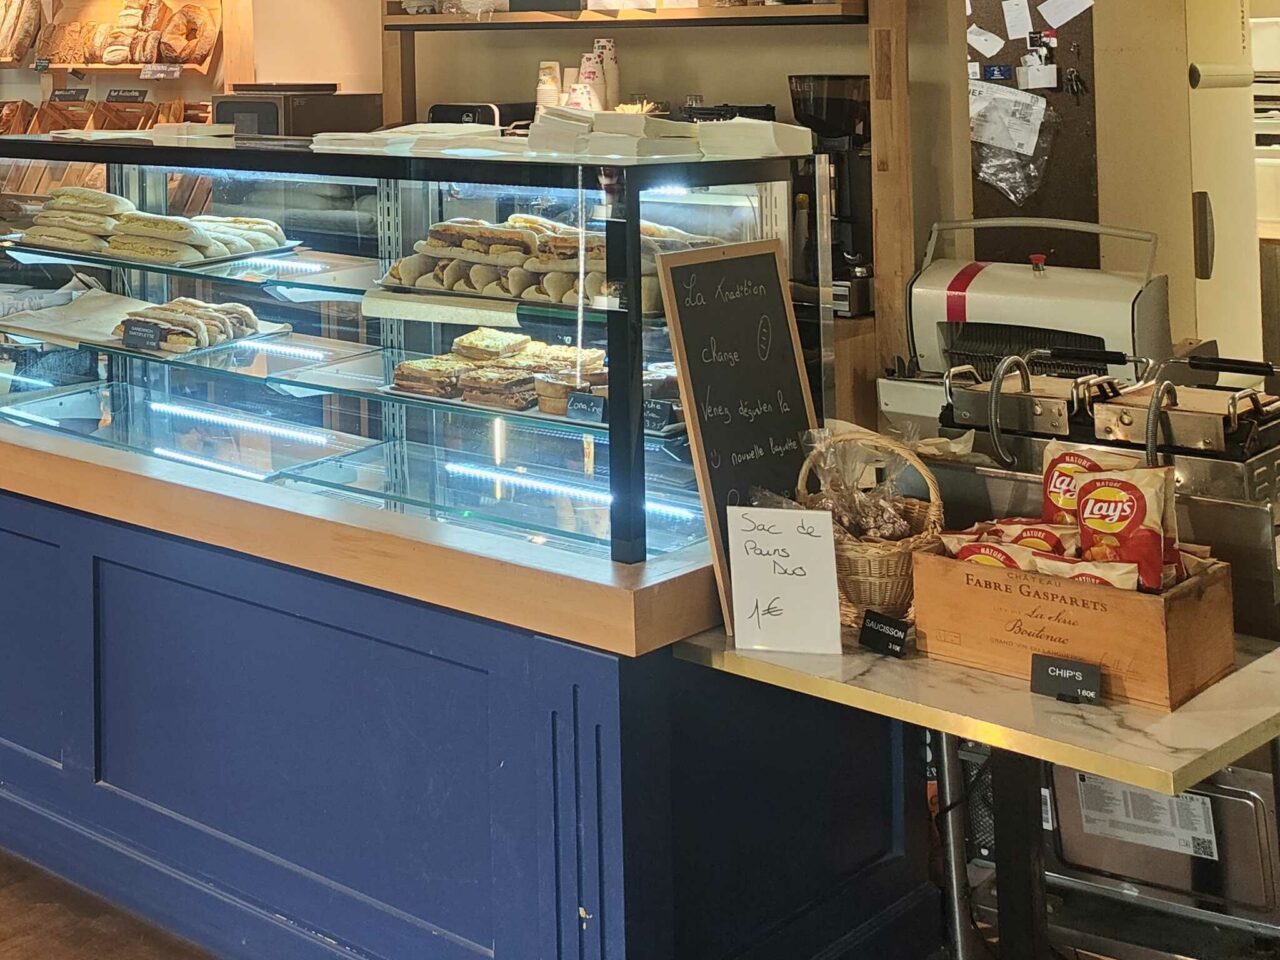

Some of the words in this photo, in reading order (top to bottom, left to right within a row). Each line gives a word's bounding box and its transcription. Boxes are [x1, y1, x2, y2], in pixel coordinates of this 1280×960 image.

[682, 273, 706, 306] La
[777, 390, 790, 414] la
[1065, 456, 1091, 468] NATURE
[1083, 498, 1133, 523] Lay's
[741, 513, 783, 534] Sac
[797, 518, 822, 538] de
[1022, 530, 1046, 539] NATURE
[744, 540, 790, 558] Pains
[980, 547, 1006, 561] NATURE
[1007, 572, 1061, 587] CHÂTEAU
[965, 573, 1013, 593] FABRE
[1019, 583, 1108, 612] GASPARETS
[747, 597, 784, 630] 1€
[1026, 605, 1045, 620] La
[865, 619, 905, 639] SAUCISSON
[1048, 666, 1083, 681] CHIP'S
